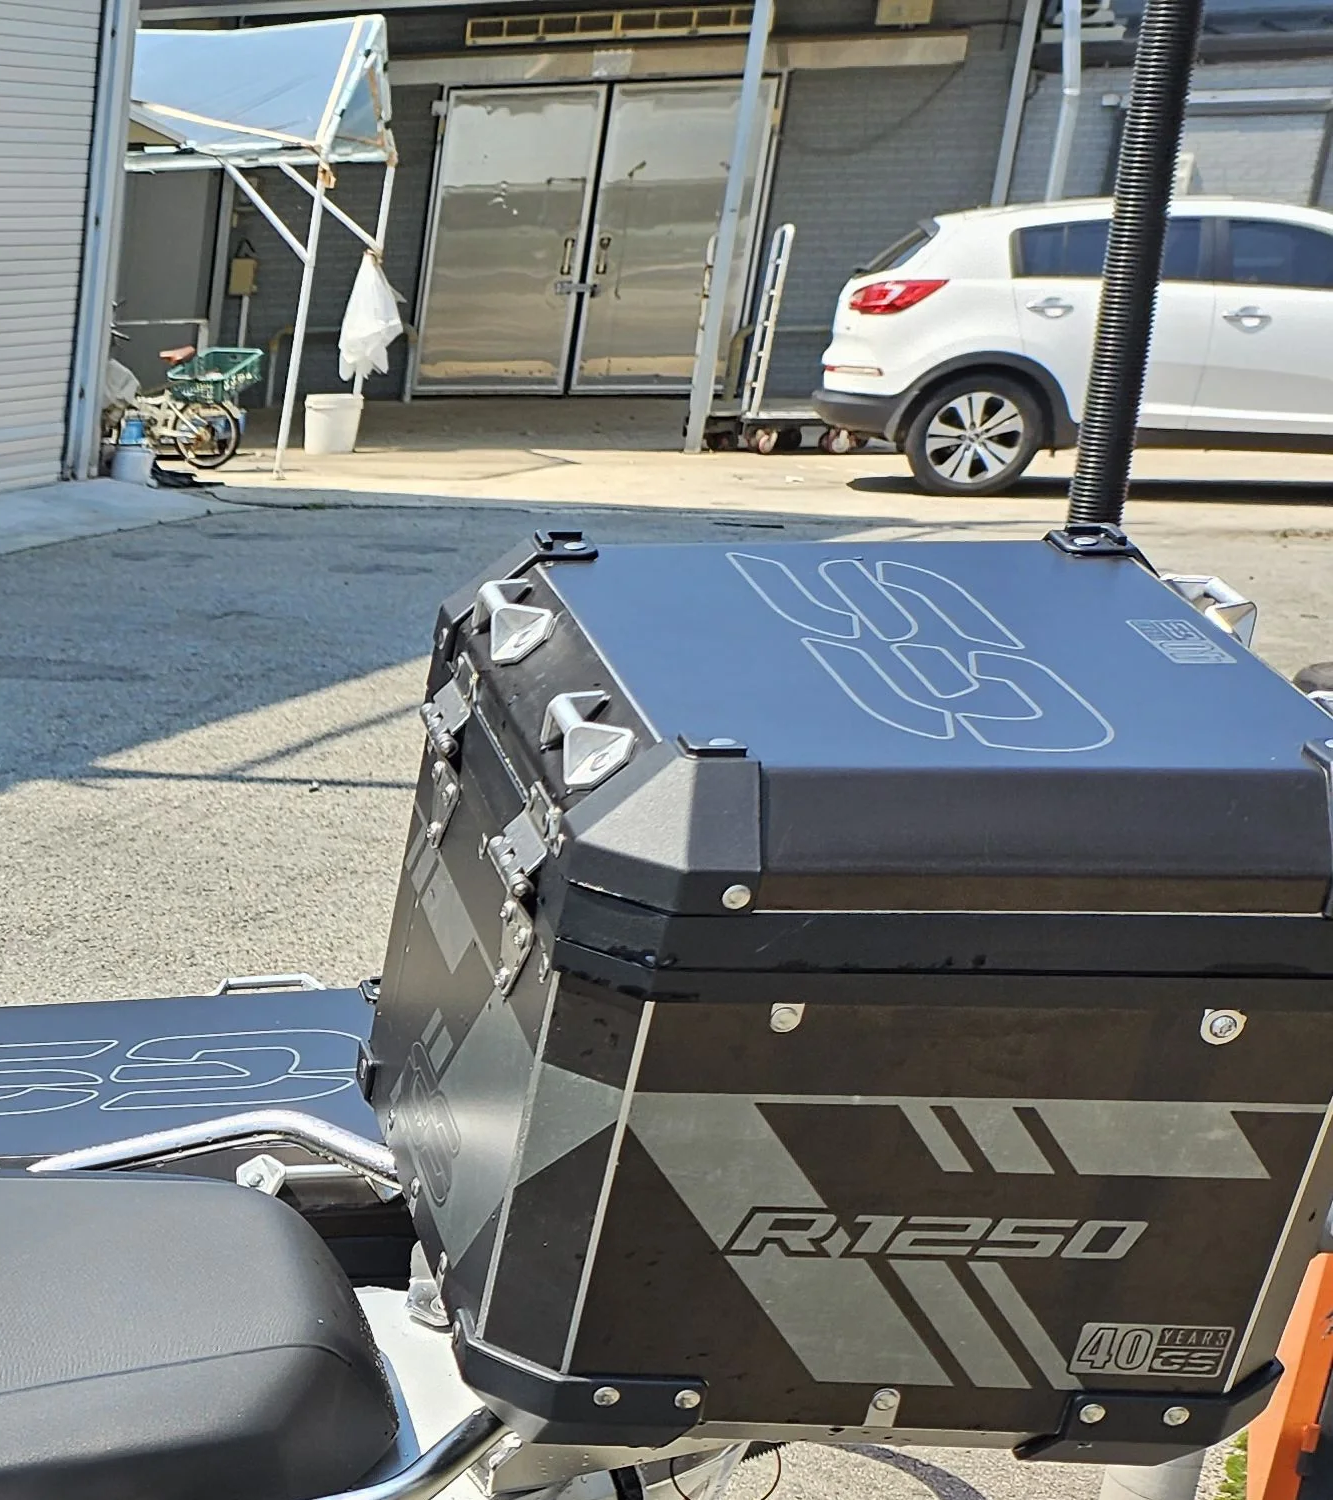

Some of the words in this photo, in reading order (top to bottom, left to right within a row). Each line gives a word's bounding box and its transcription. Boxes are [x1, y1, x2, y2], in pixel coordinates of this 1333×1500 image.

[725, 552, 1116, 752] GS
[1077, 1327, 1154, 1371] 40
[1161, 1329, 1228, 1346] YEARS
[1150, 1350, 1222, 1372] GS
